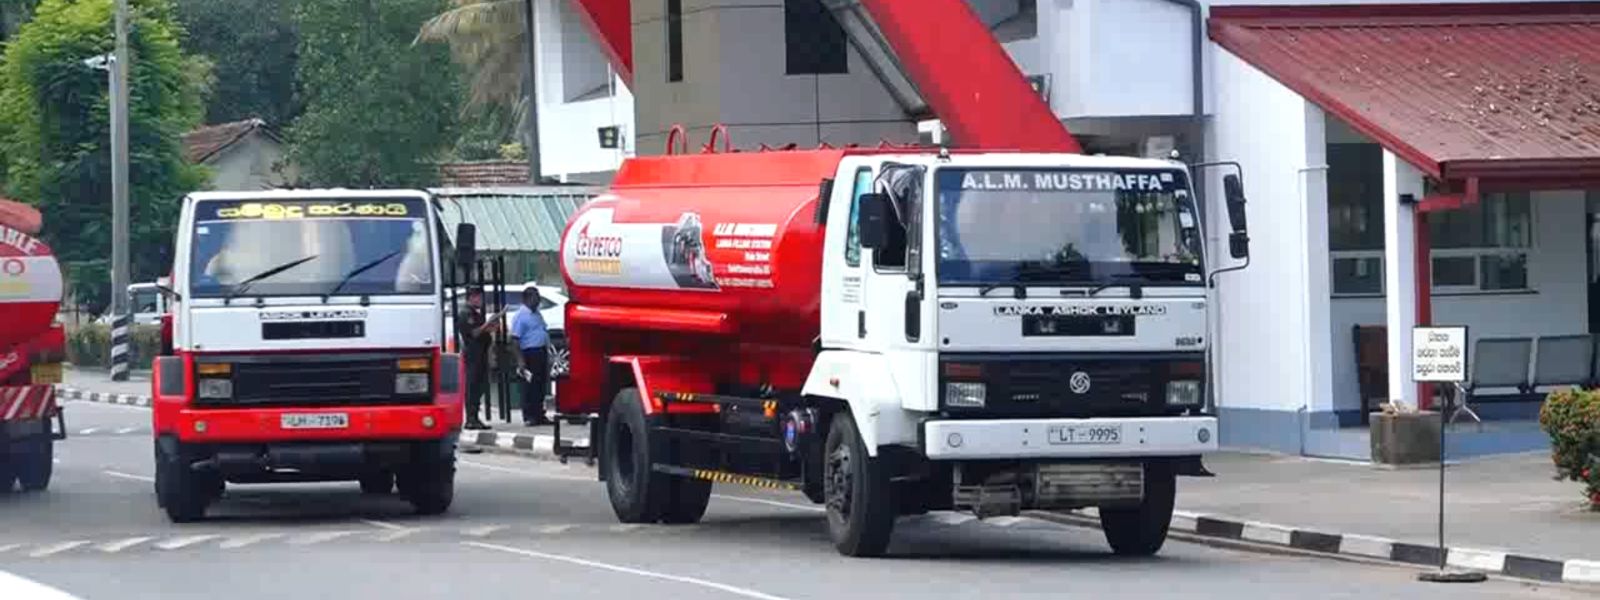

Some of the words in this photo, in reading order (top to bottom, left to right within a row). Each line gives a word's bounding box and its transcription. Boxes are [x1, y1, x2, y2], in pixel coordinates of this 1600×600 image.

[962, 173, 1028, 190] A.L.M.
[1035, 173, 1163, 190] MUSTHAFFA
[994, 305, 1044, 316] LANKA
[1051, 305, 1100, 316] ASHOK
[1106, 305, 1167, 316] LEYLAND
